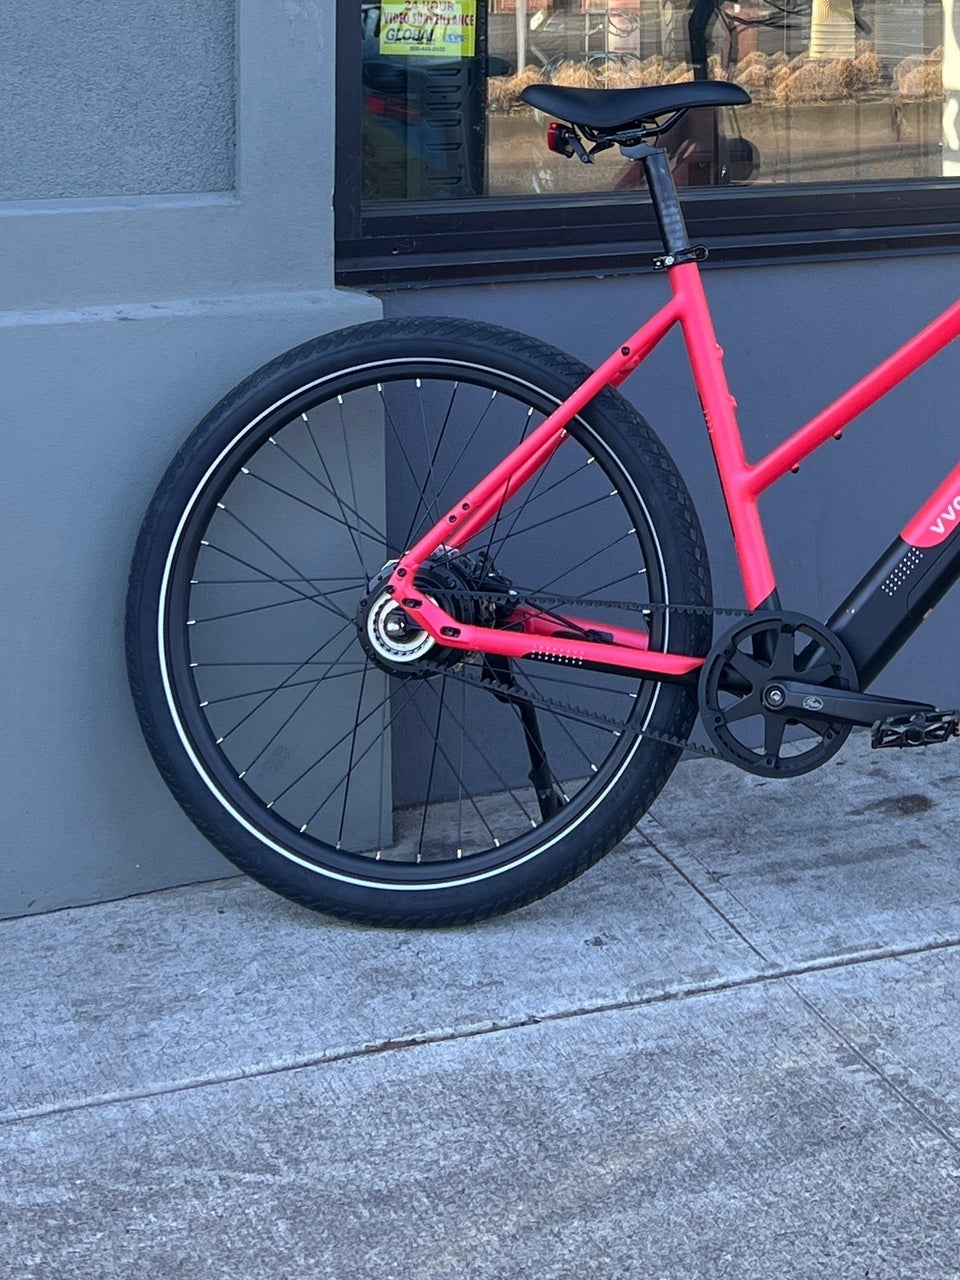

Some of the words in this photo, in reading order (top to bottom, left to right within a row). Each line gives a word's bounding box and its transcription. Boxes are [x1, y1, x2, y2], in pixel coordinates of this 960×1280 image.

[404, 1, 418, 10] 24
[422, 1, 454, 11] HOUR
[384, 12, 410, 24] VIDEO
[412, 13, 474, 26] SURVEILLANCE
[386, 28, 436, 42] GLOBAL
